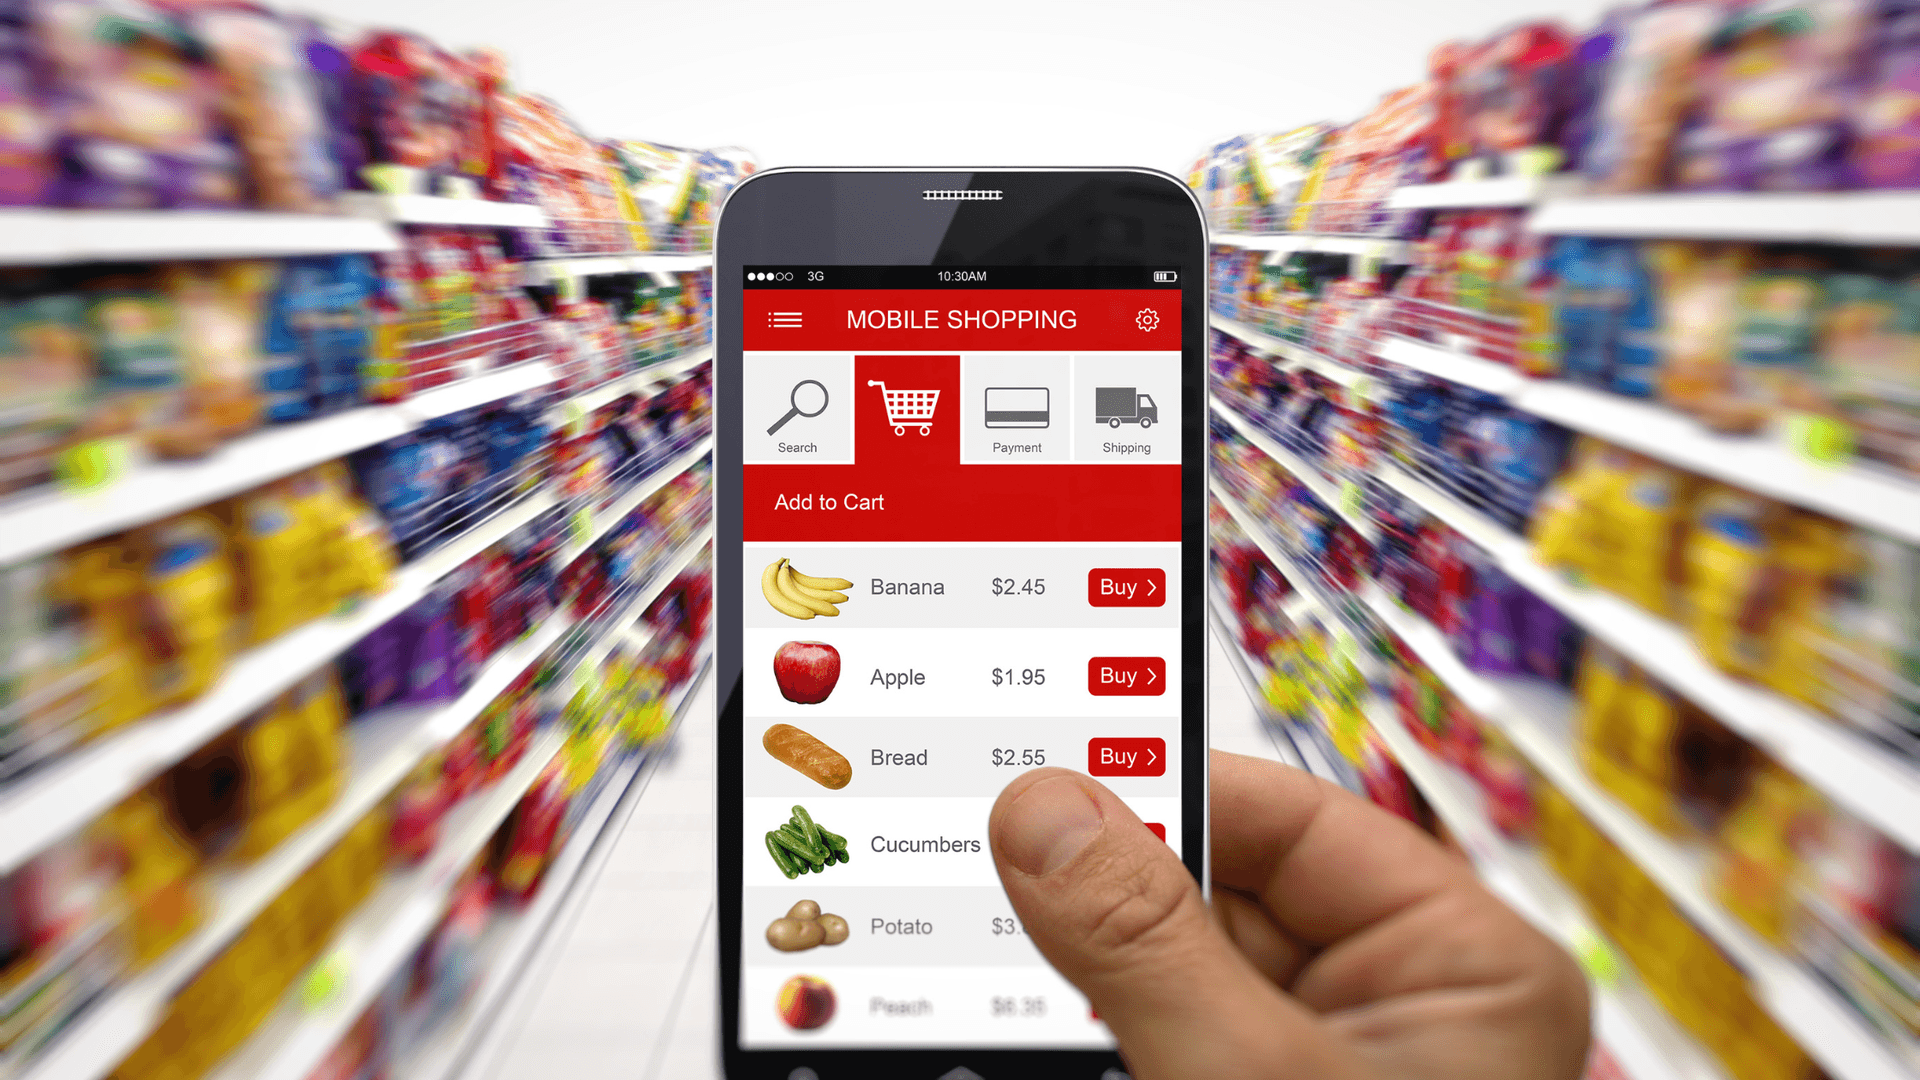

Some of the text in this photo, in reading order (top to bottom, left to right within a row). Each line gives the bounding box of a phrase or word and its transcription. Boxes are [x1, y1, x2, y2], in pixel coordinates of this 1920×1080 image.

[808, 271, 825, 282] 3G
[937, 271, 987, 282] 10:30AM
[847, 309, 1077, 330] MOBILE SHOPPING
[778, 442, 818, 453] Search
[993, 442, 1042, 456] Payment
[1103, 442, 1151, 456] Shipping
[774, 493, 885, 511] Add to Cart
[871, 577, 1046, 597] Banana $2.45
[1100, 578, 1138, 600] Buy
[870, 667, 1046, 690] Apple $1.95
[1100, 667, 1138, 689] Buy
[871, 748, 1046, 767] Bread $2.55
[1100, 748, 1138, 769] Buy
[871, 835, 982, 853] Cucumbers
[871, 917, 1026, 936] Potato $3.
